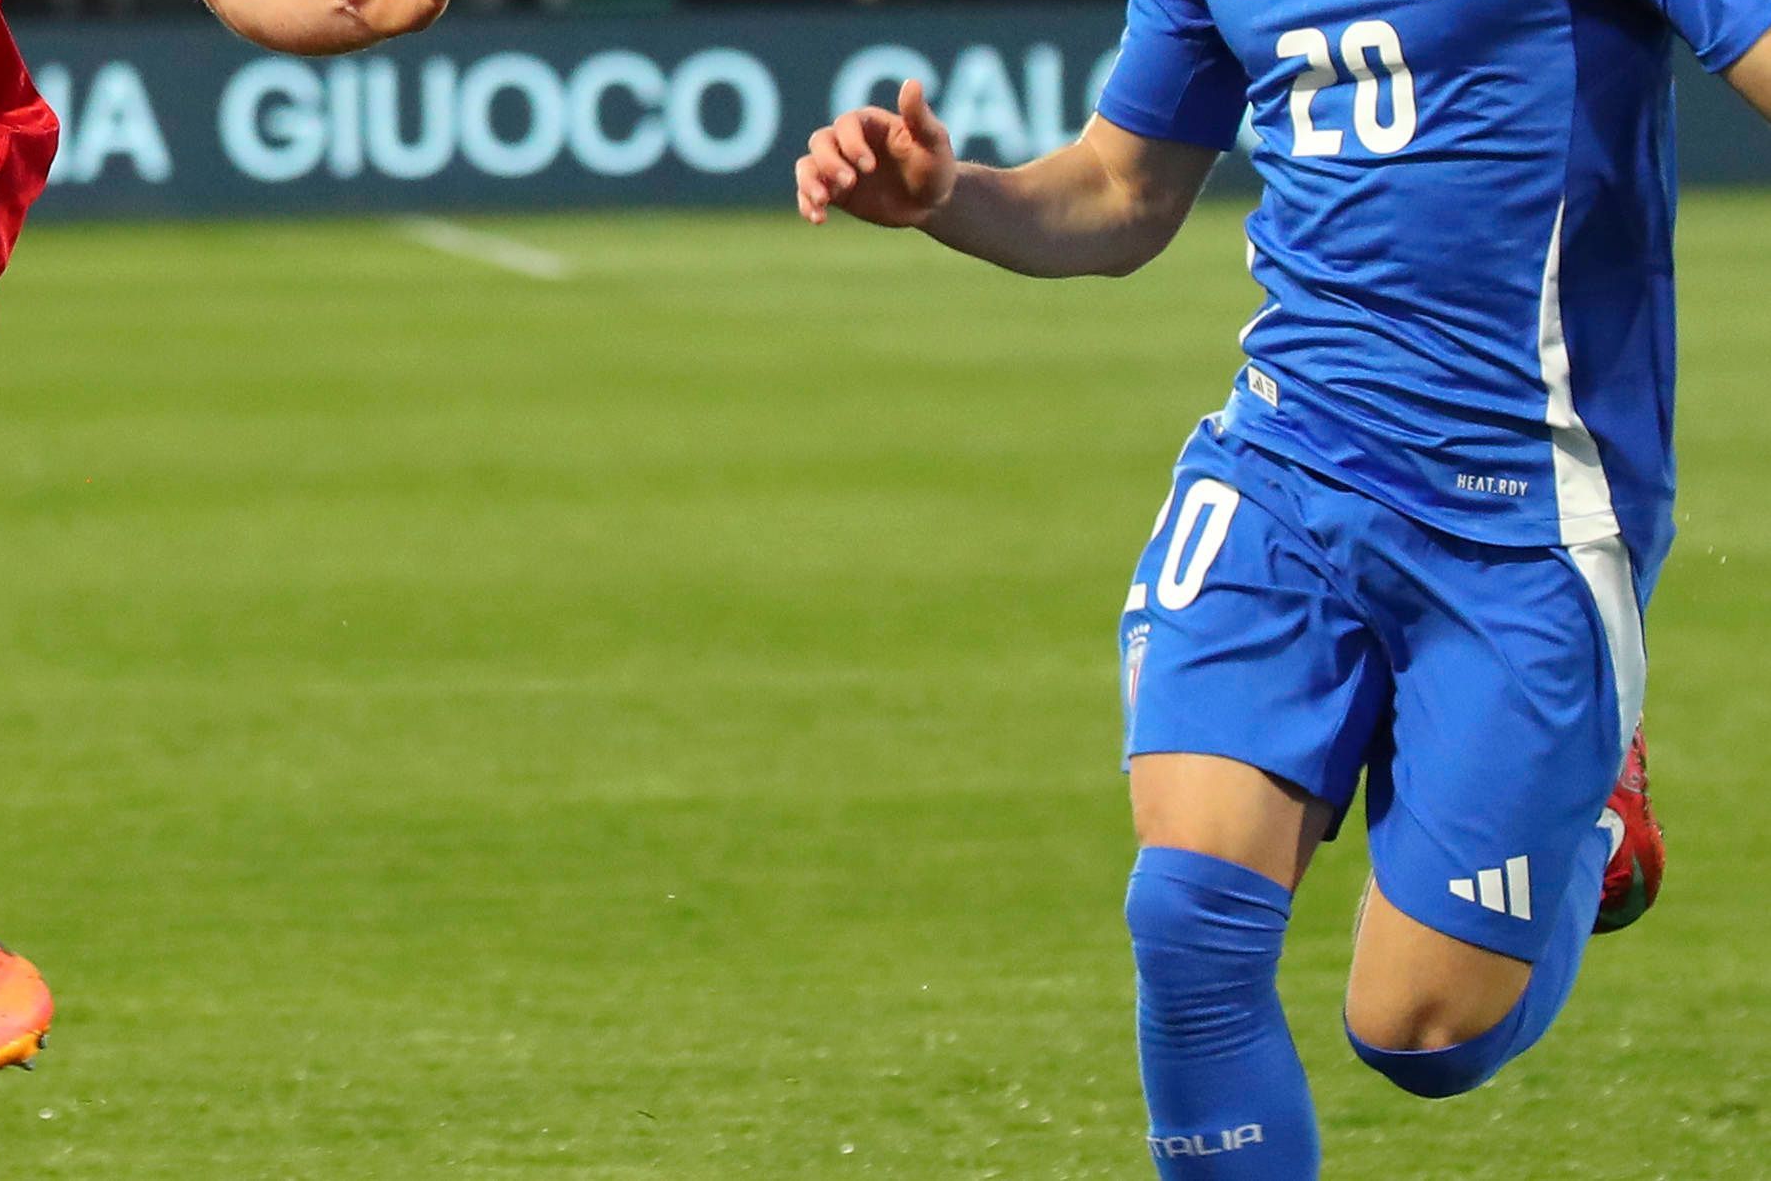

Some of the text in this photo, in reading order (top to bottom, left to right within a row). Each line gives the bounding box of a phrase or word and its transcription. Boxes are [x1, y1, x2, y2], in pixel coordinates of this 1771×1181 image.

[218, 46, 781, 183] GIUOCO
[832, 42, 1121, 167] CAL
[1276, 19, 1417, 157] 20
[1456, 473, 1528, 497] HEAT.RDY
